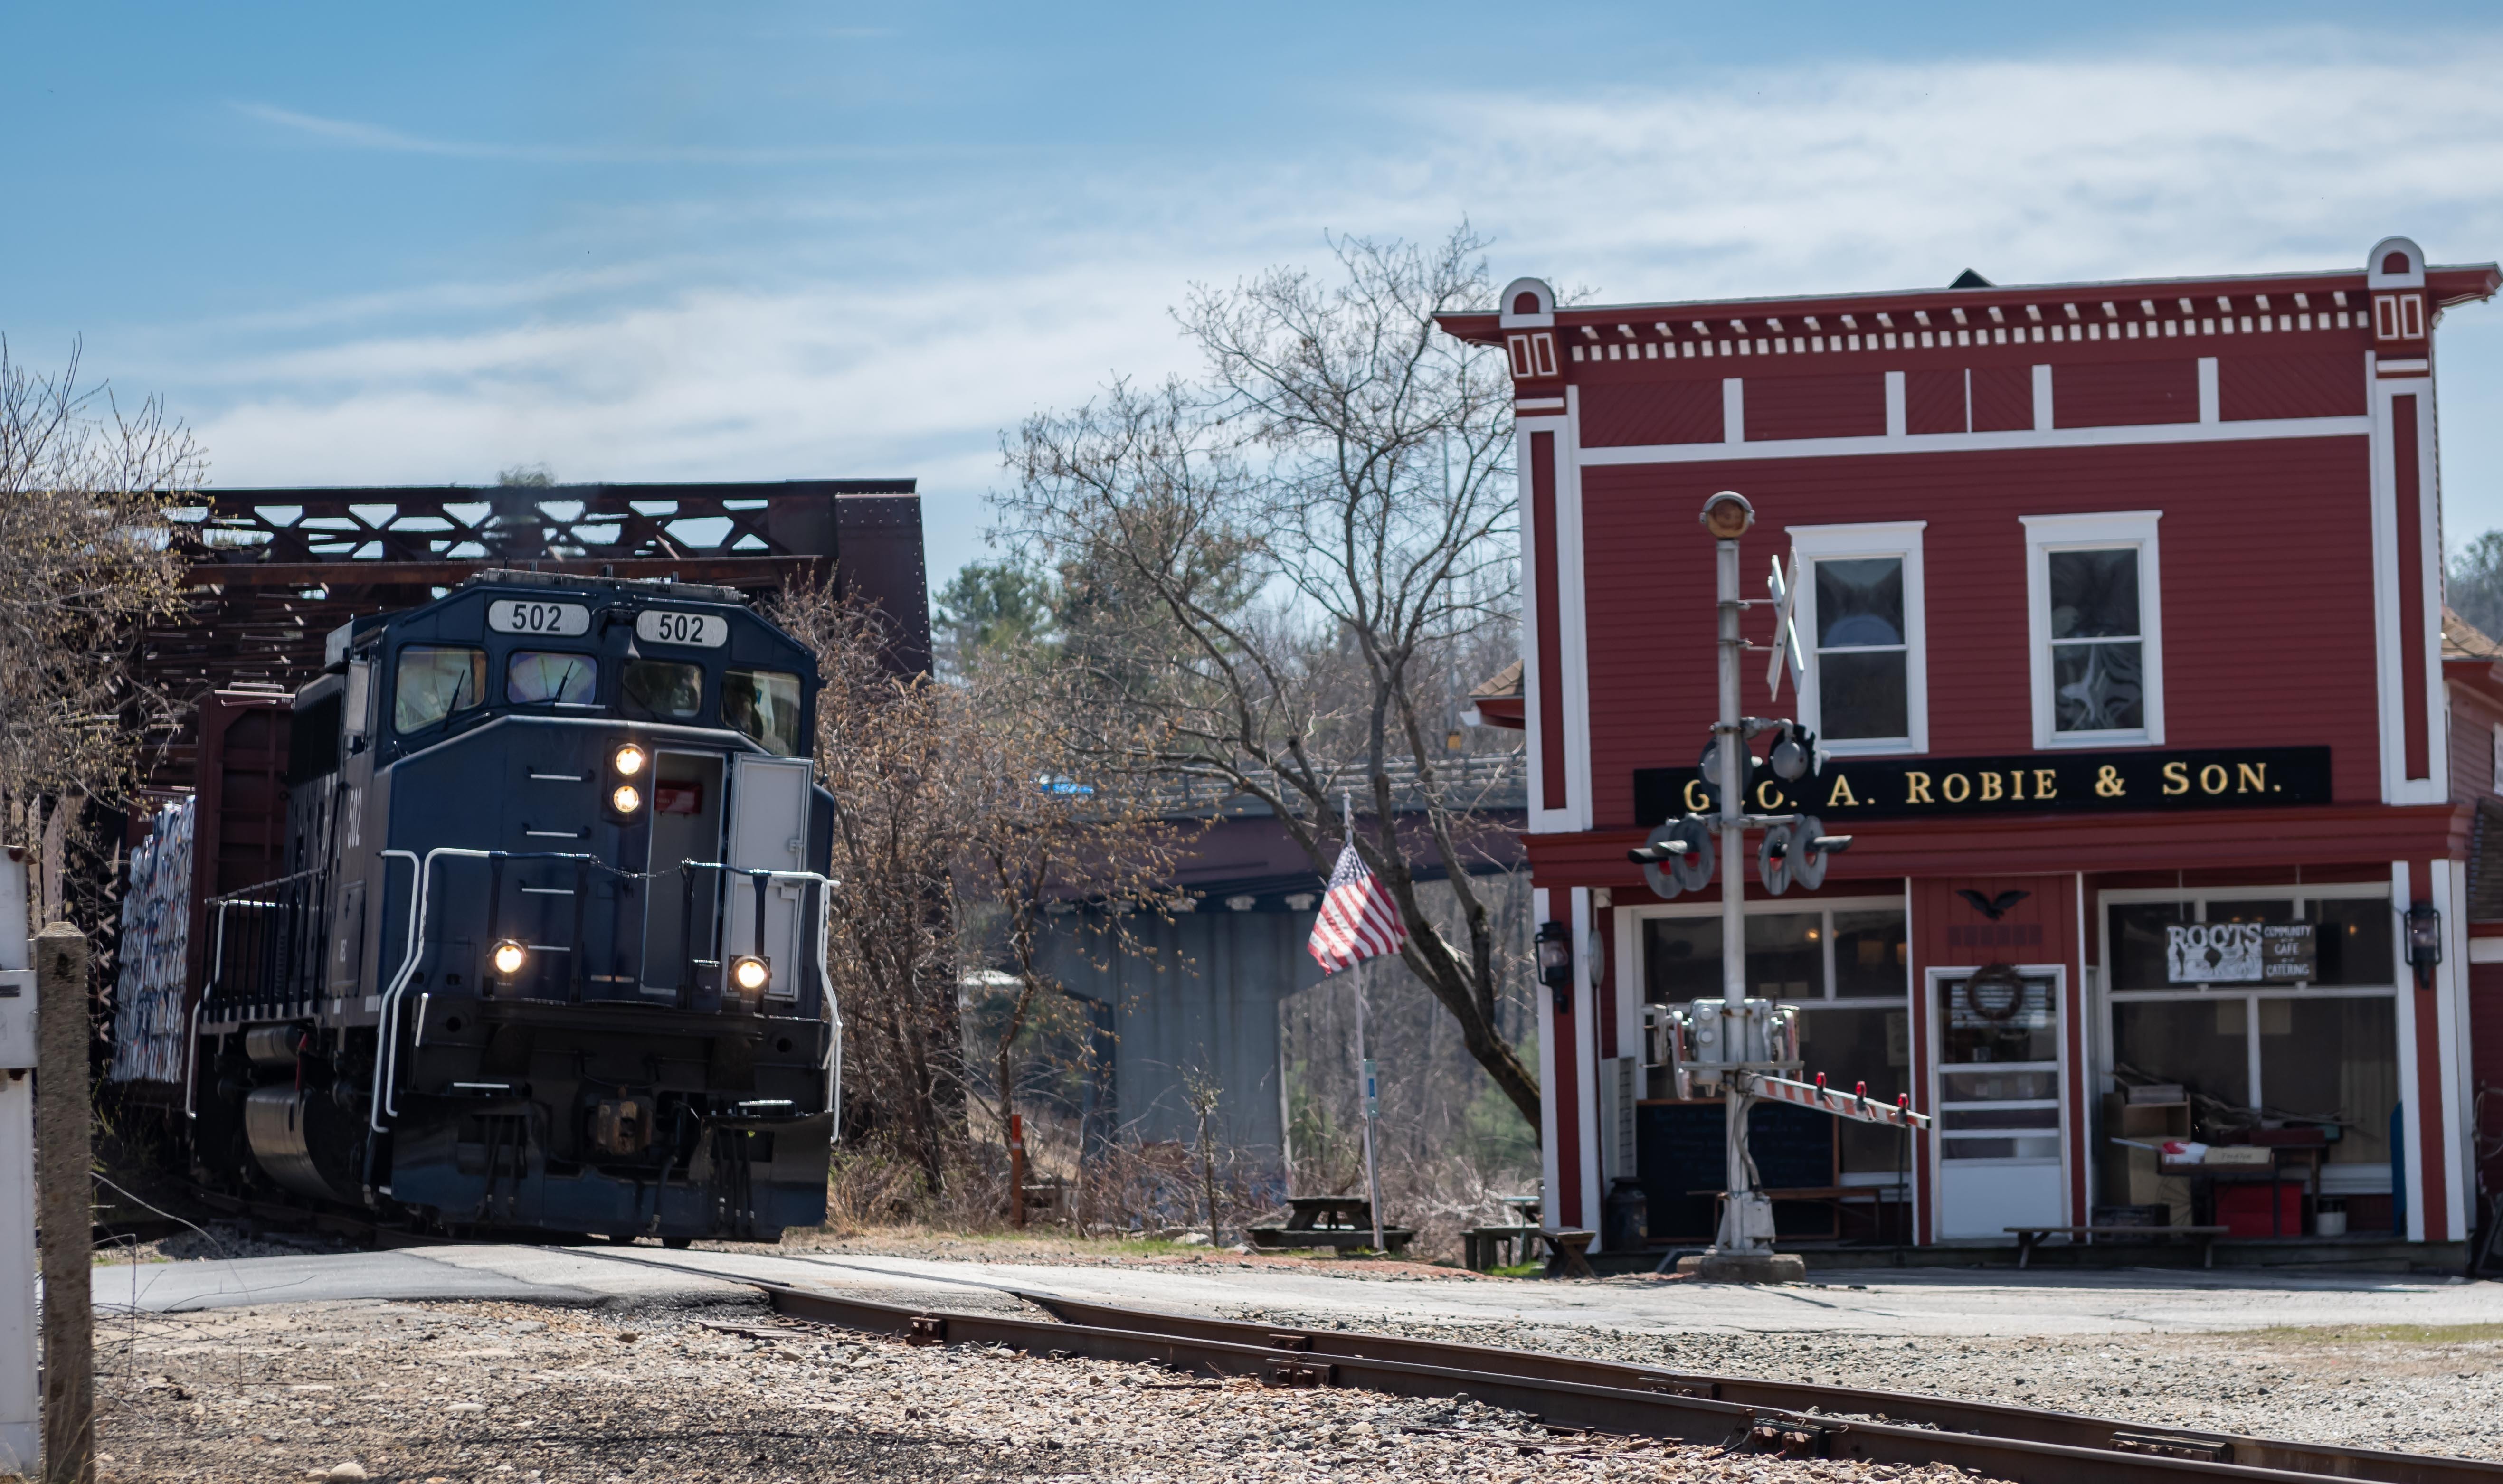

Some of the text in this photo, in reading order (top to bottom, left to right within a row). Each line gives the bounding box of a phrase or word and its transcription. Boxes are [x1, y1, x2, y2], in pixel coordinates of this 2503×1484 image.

[512, 603, 562, 633] 502
[658, 613, 704, 643] 502
[1683, 762, 2282, 812] GO. A. ROBIE & SON.
[347, 787, 362, 849] 502
[2167, 923, 2263, 950] ROOTS
[2264, 925, 2312, 938] COMMUNITY
[2274, 942, 2299, 955] CAFE
[2266, 964, 2309, 977] CATERING
